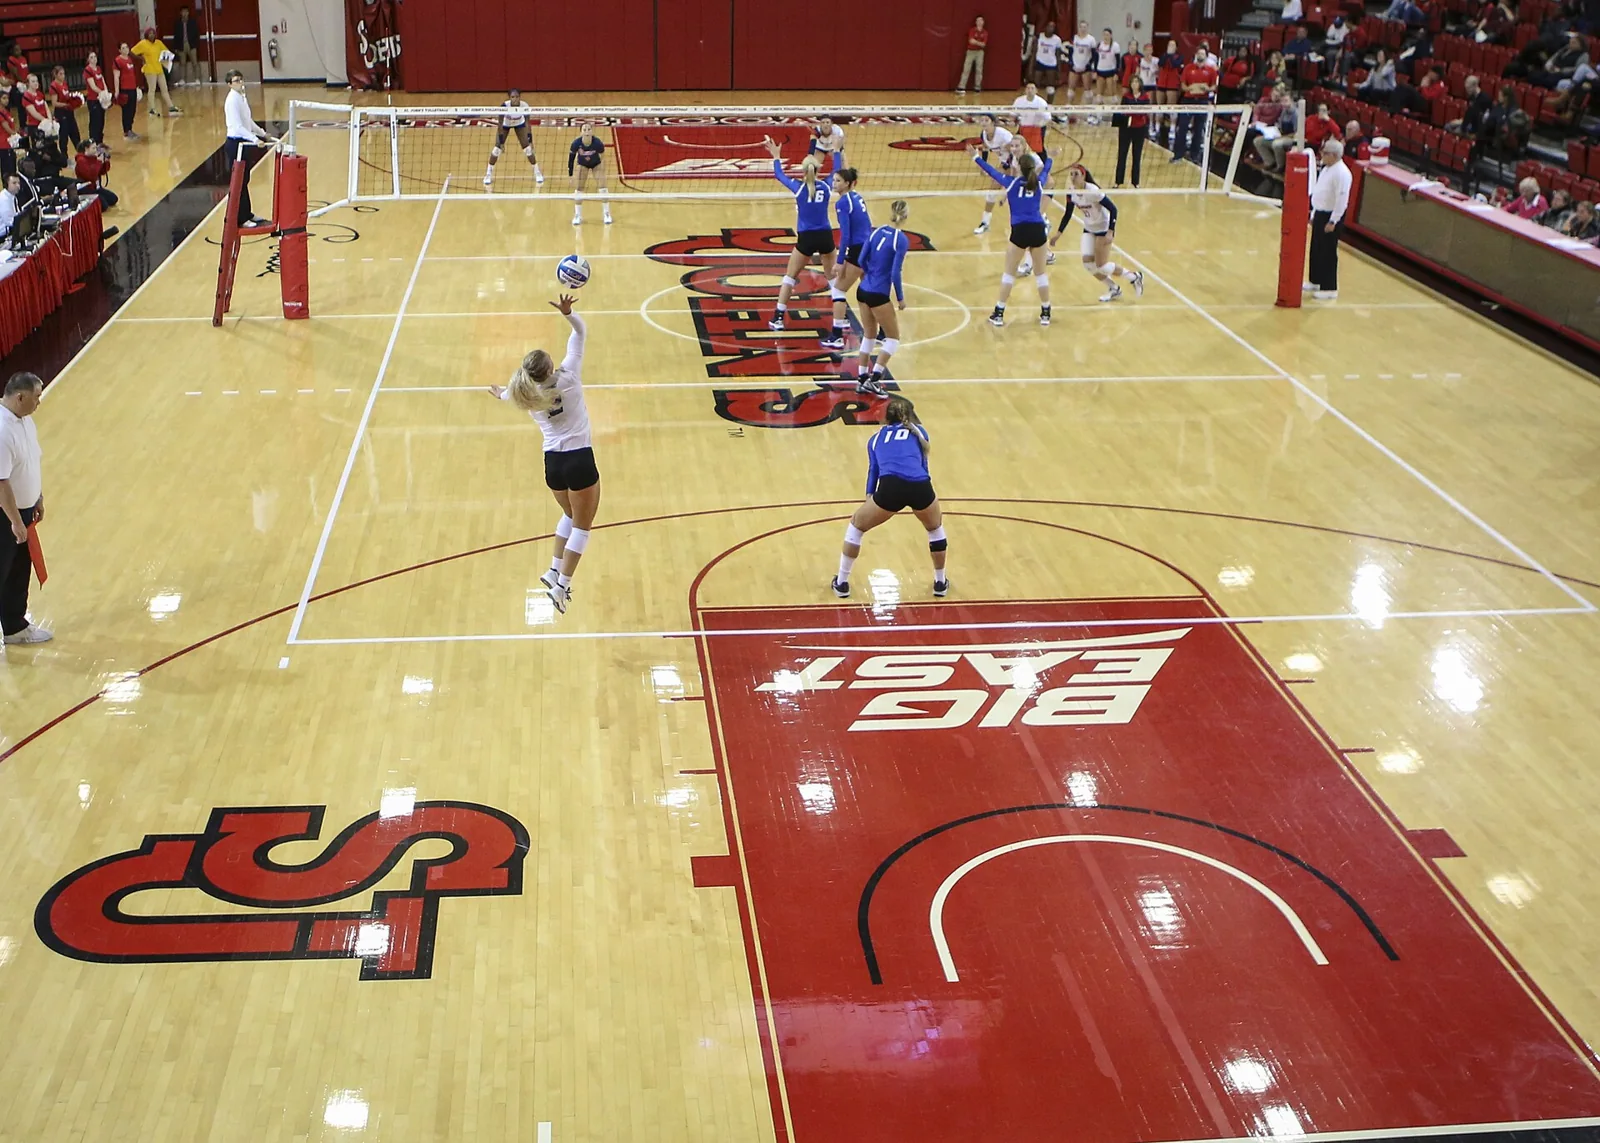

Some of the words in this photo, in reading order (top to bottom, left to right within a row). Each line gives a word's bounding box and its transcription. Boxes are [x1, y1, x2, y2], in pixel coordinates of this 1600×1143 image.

[858, 198, 867, 213] 5
[876, 237, 887, 252] 1
[884, 428, 910, 444] 10
[754, 647, 1175, 692] EAST
[848, 684, 1152, 732] BIG
